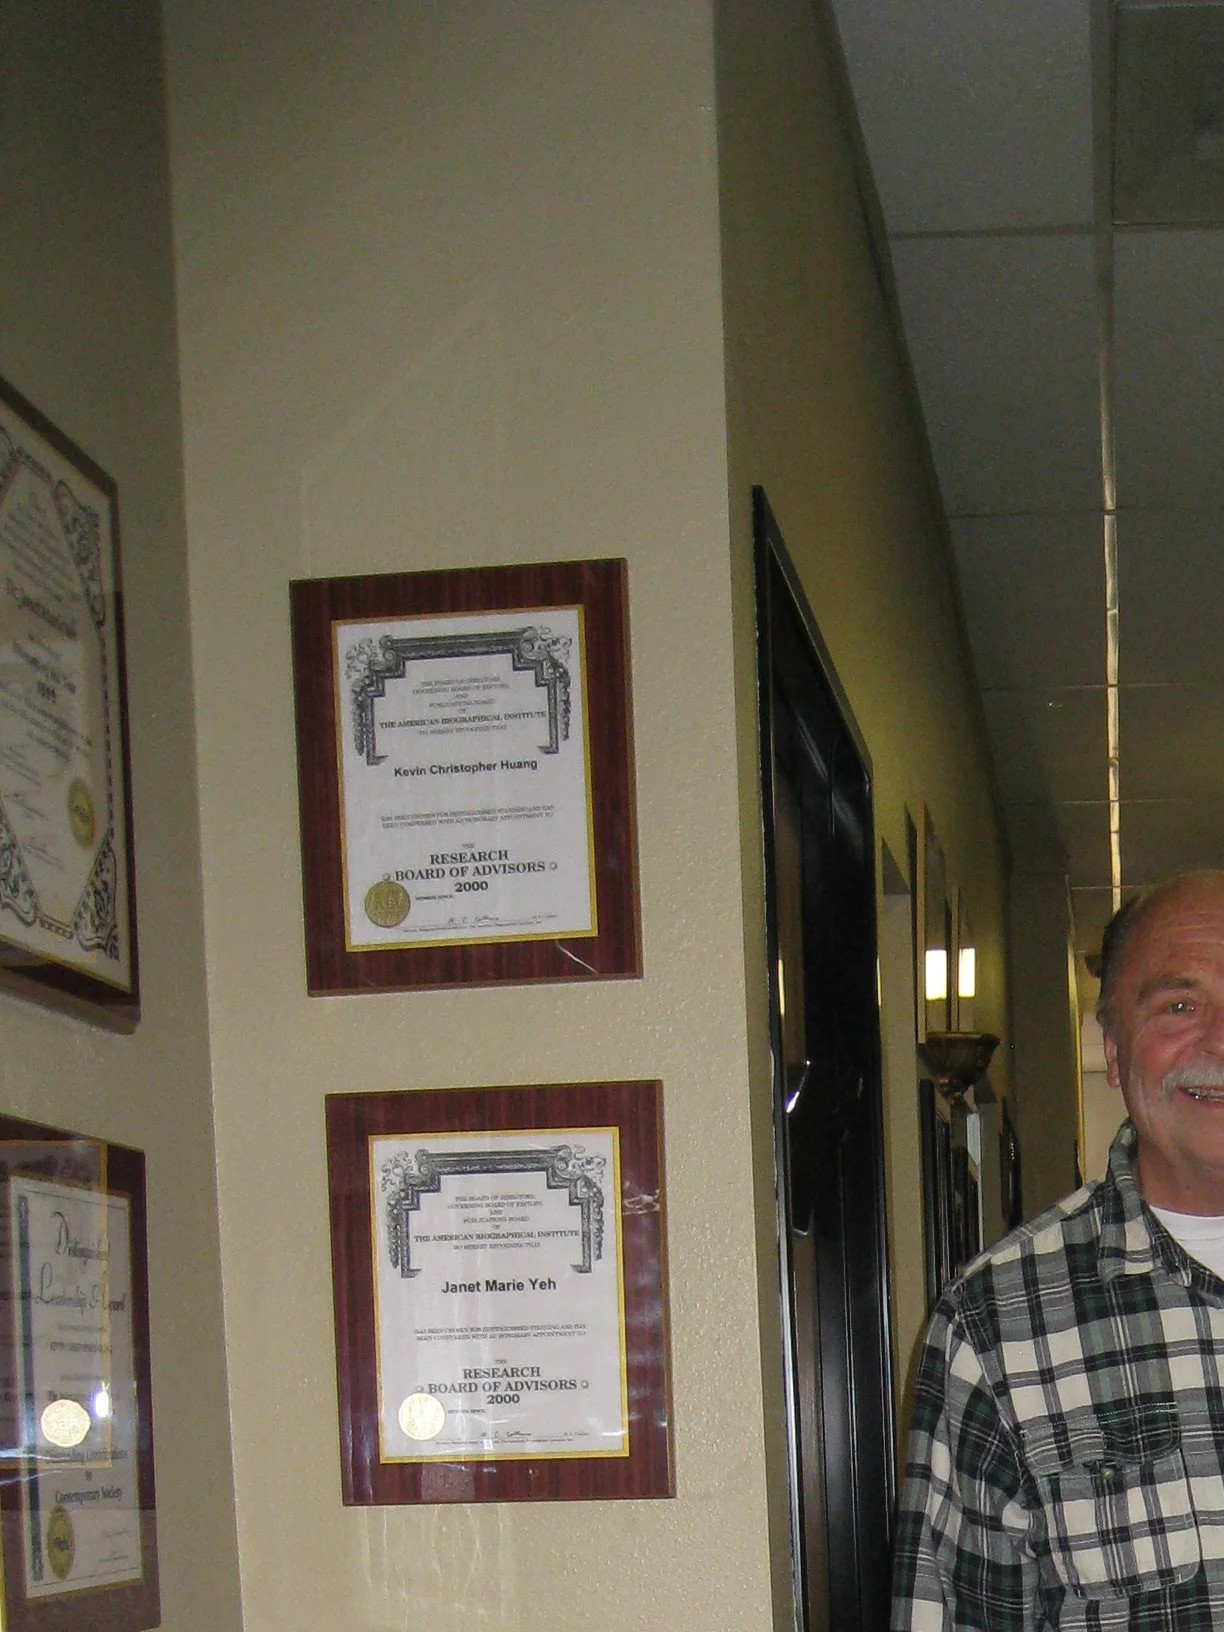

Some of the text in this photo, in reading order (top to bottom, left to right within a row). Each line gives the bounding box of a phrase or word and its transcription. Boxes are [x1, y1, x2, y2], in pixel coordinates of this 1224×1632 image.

[394, 759, 538, 777] Kevin Christopher Huang
[430, 850, 509, 865] RESEARCH
[395, 861, 546, 882] BOARD OF ADVISORS
[454, 881, 488, 893] 2000
[432, 1232, 474, 1242] AMERICAN
[441, 1278, 557, 1294] Janet Marie Yeh
[463, 1366, 541, 1380] RESEARCH
[428, 1379, 577, 1394] BOARD OF ADVISORS
[486, 1393, 520, 1405] 2000
